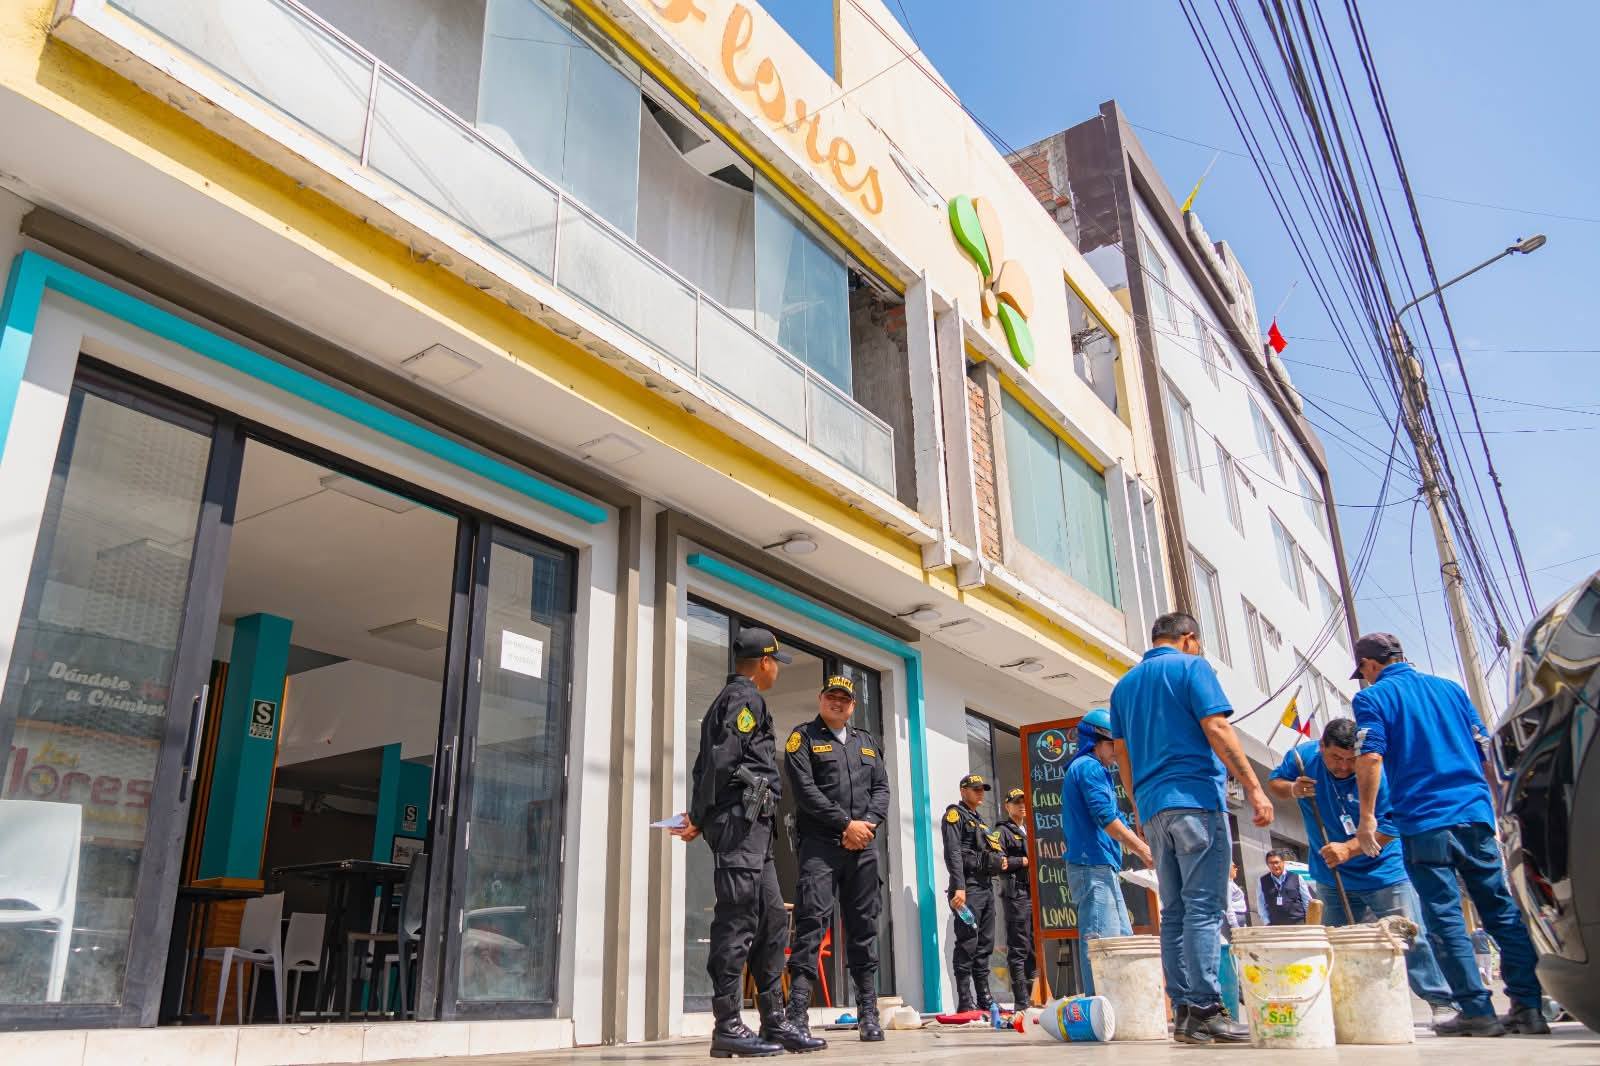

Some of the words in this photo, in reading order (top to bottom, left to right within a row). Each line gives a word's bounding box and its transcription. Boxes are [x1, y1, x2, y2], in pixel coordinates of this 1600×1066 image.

[652, 0, 884, 215] lores
[256, 703, 272, 725] S
[8, 744, 154, 809] lores
[1041, 905, 1077, 928] LOMO
[1268, 1010, 1293, 1024] Sal
